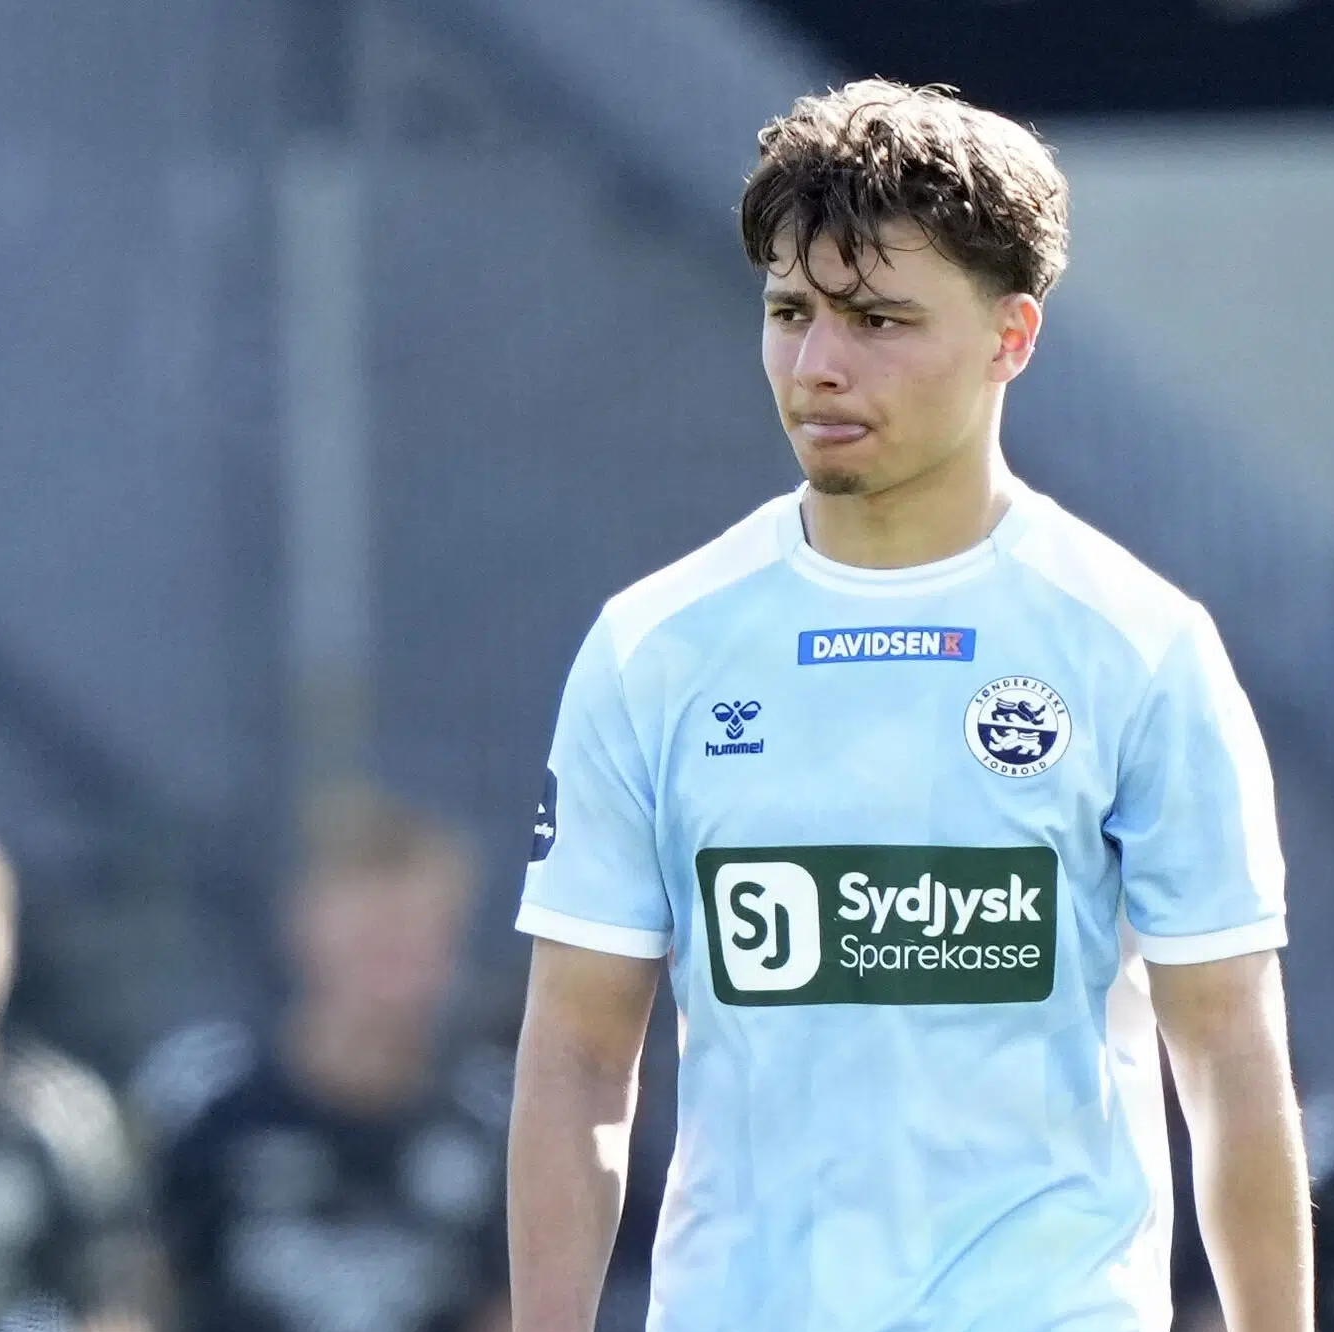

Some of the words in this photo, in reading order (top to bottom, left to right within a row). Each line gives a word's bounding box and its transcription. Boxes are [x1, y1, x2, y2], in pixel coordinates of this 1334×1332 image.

[812, 631, 941, 659] DAVIDSEN
[705, 738, 764, 757] hummel
[982, 755, 1047, 775] FODBOLD
[729, 880, 791, 970] SJ
[839, 934, 1041, 977] Sparekasse
